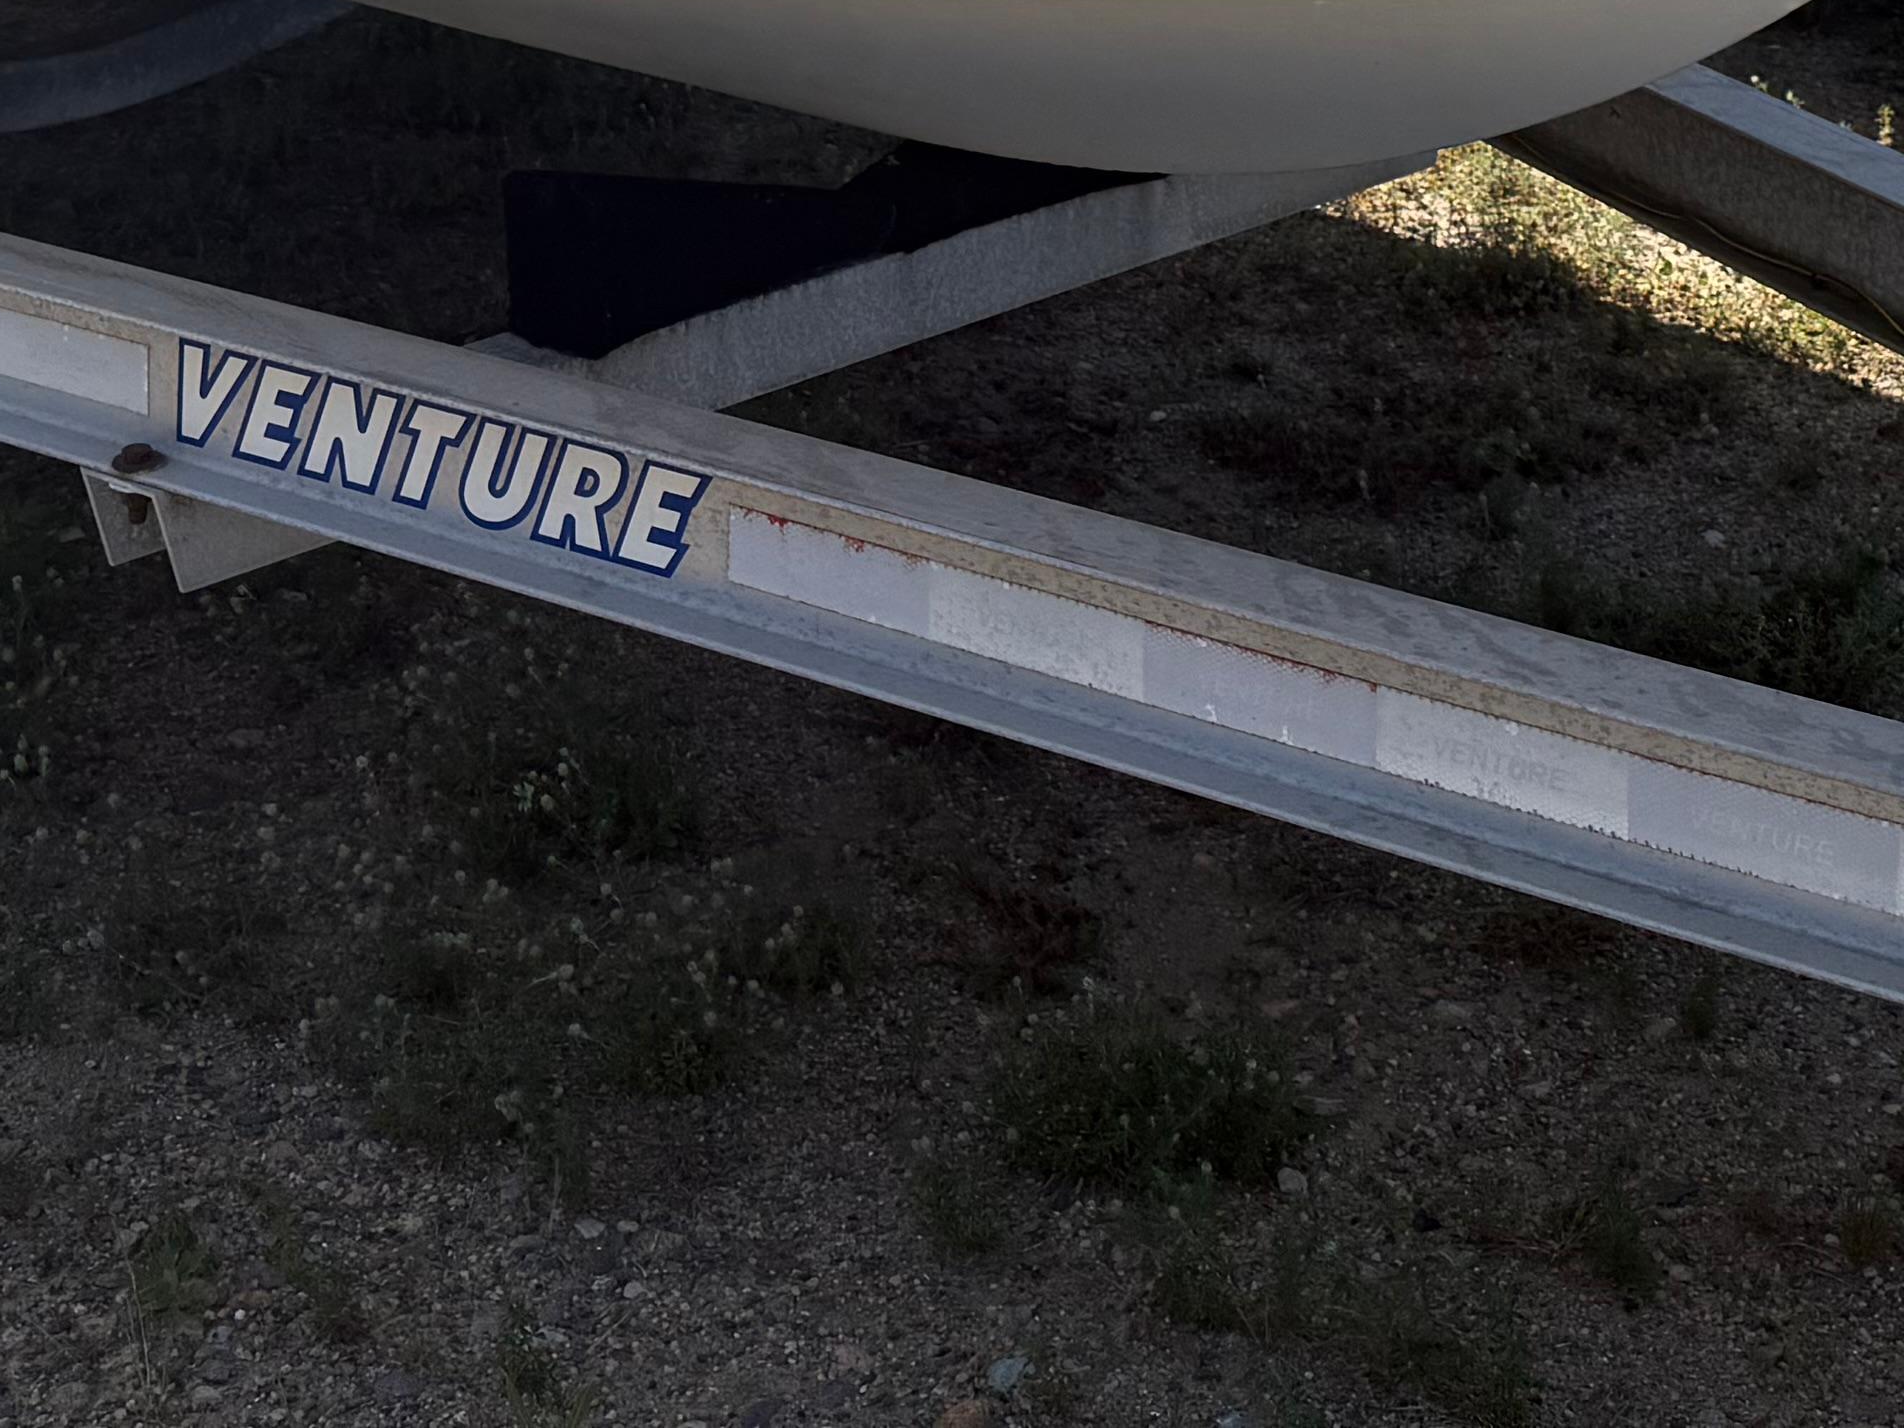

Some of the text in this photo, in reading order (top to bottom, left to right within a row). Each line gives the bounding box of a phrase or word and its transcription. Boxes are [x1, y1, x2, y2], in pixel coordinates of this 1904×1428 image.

[177, 338, 712, 578] VENTURE
[1433, 736, 1567, 793] VENTURE
[1690, 804, 1834, 867] VENTURE
